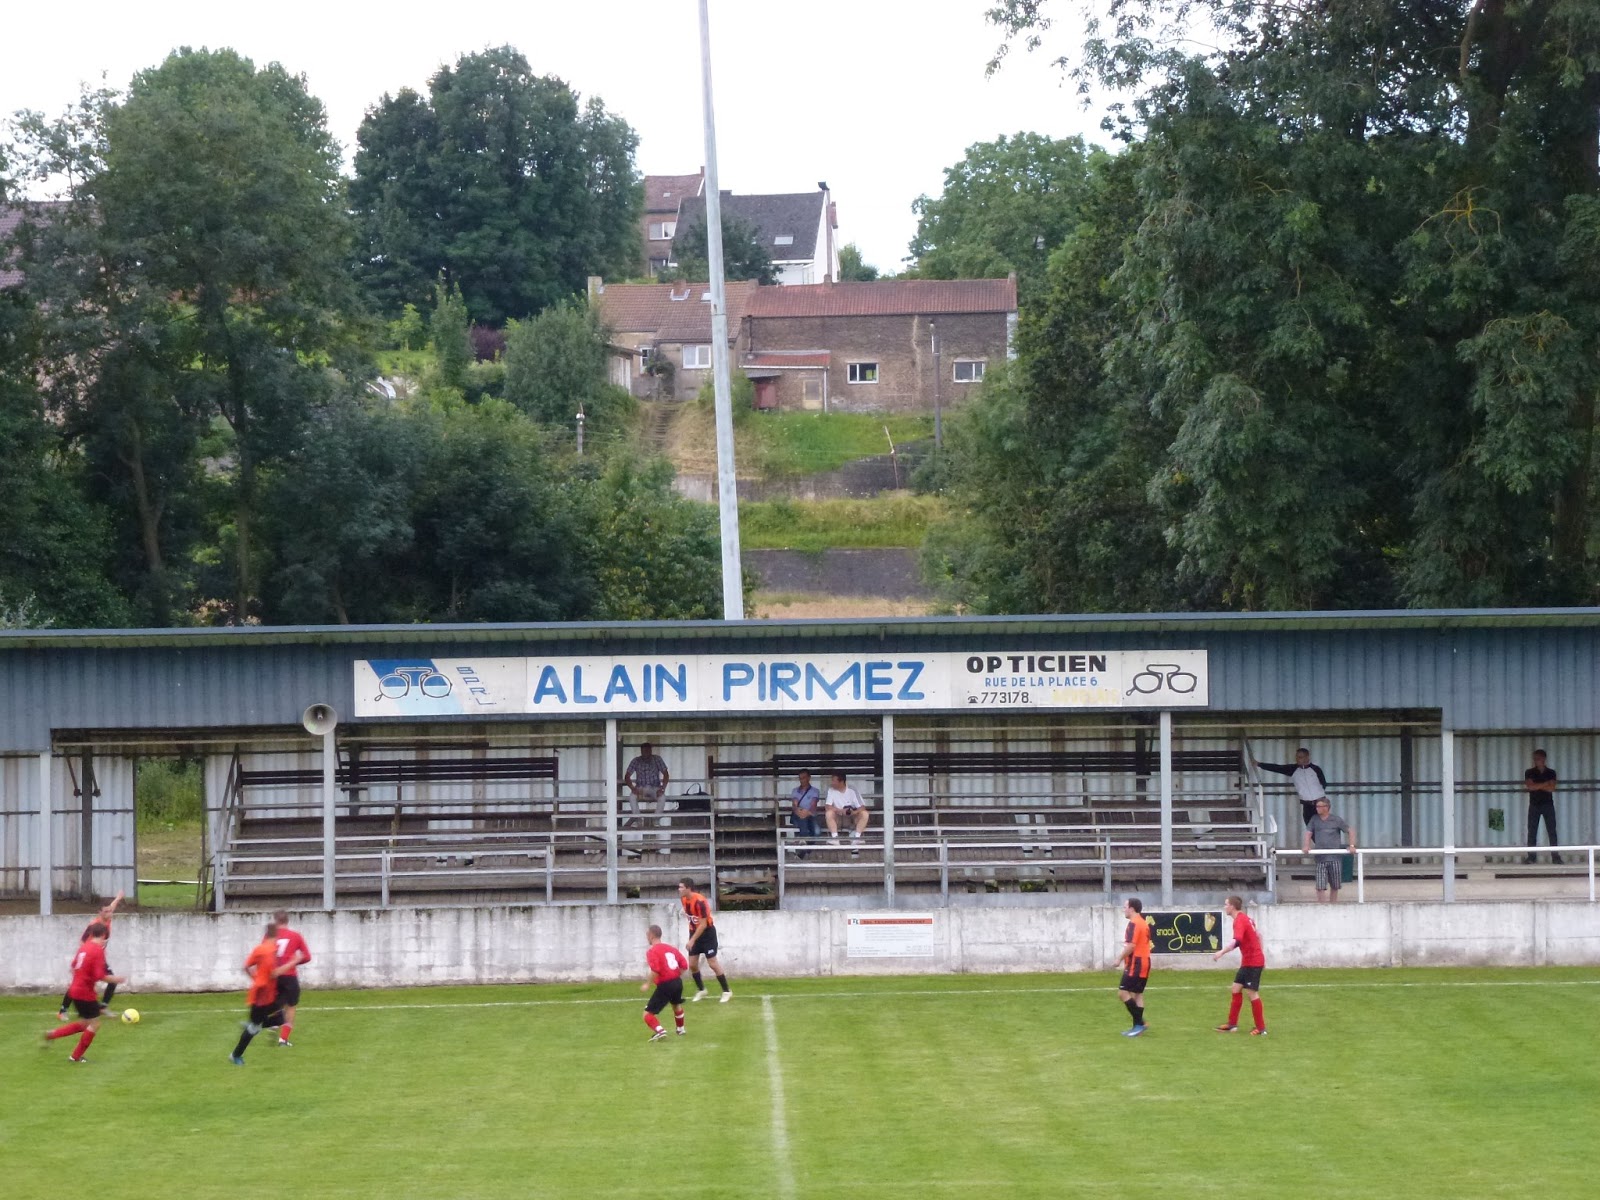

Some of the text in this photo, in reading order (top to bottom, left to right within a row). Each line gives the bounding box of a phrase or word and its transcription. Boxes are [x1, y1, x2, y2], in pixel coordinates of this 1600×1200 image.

[966, 654, 1107, 673] OPTICIEN
[533, 661, 925, 704] ALAIN PIRMEZ
[985, 675, 1098, 687] RUE DE LA PLACE 6
[1157, 928, 1175, 936] snack
[1186, 934, 1202, 944] Gold
[665, 952, 679, 969] 8
